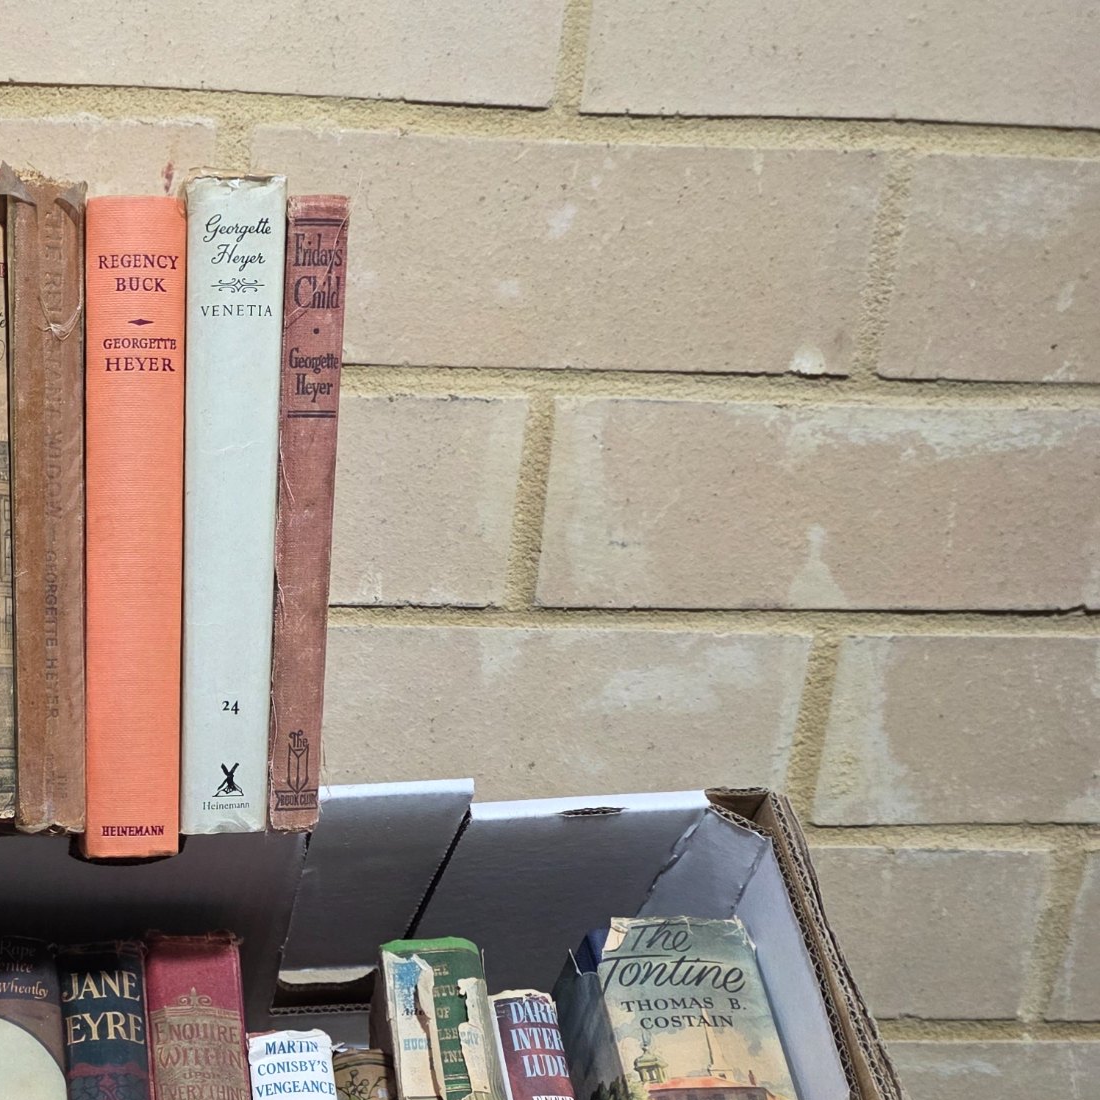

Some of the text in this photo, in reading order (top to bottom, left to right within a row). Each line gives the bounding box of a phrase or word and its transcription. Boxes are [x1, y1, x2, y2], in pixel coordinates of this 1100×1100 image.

[202, 214, 272, 245] Georgette
[98, 253, 179, 271] REGENCY
[211, 243, 266, 274] Heyer
[114, 276, 167, 293] BUCK
[294, 276, 341, 310] Child
[200, 304, 273, 318] VENETIA
[102, 337, 177, 352] GEORGETTE
[104, 356, 176, 372] HEYER
[288, 347, 339, 374] Georgette
[294, 373, 334, 402] Heyer
[222, 700, 241, 715] 24
[288, 729, 309, 748] The
[202, 800, 250, 811] Heinemann
[101, 825, 165, 837] HEINEMANN
[631, 920, 704, 952] The
[602, 954, 746, 996] Tontine
[62, 970, 141, 1003] JANE
[620, 996, 748, 1013] THOMAS B.
[66, 1011, 145, 1046] EYRE
[639, 1014, 734, 1030] COSTAIN
[265, 1040, 319, 1055] MARTIN
[510, 1027, 565, 1051] INTER
[257, 1060, 329, 1077] CONISBY'S
[522, 1054, 570, 1078] LUDE
[255, 1080, 336, 1098] VENGEANCE
